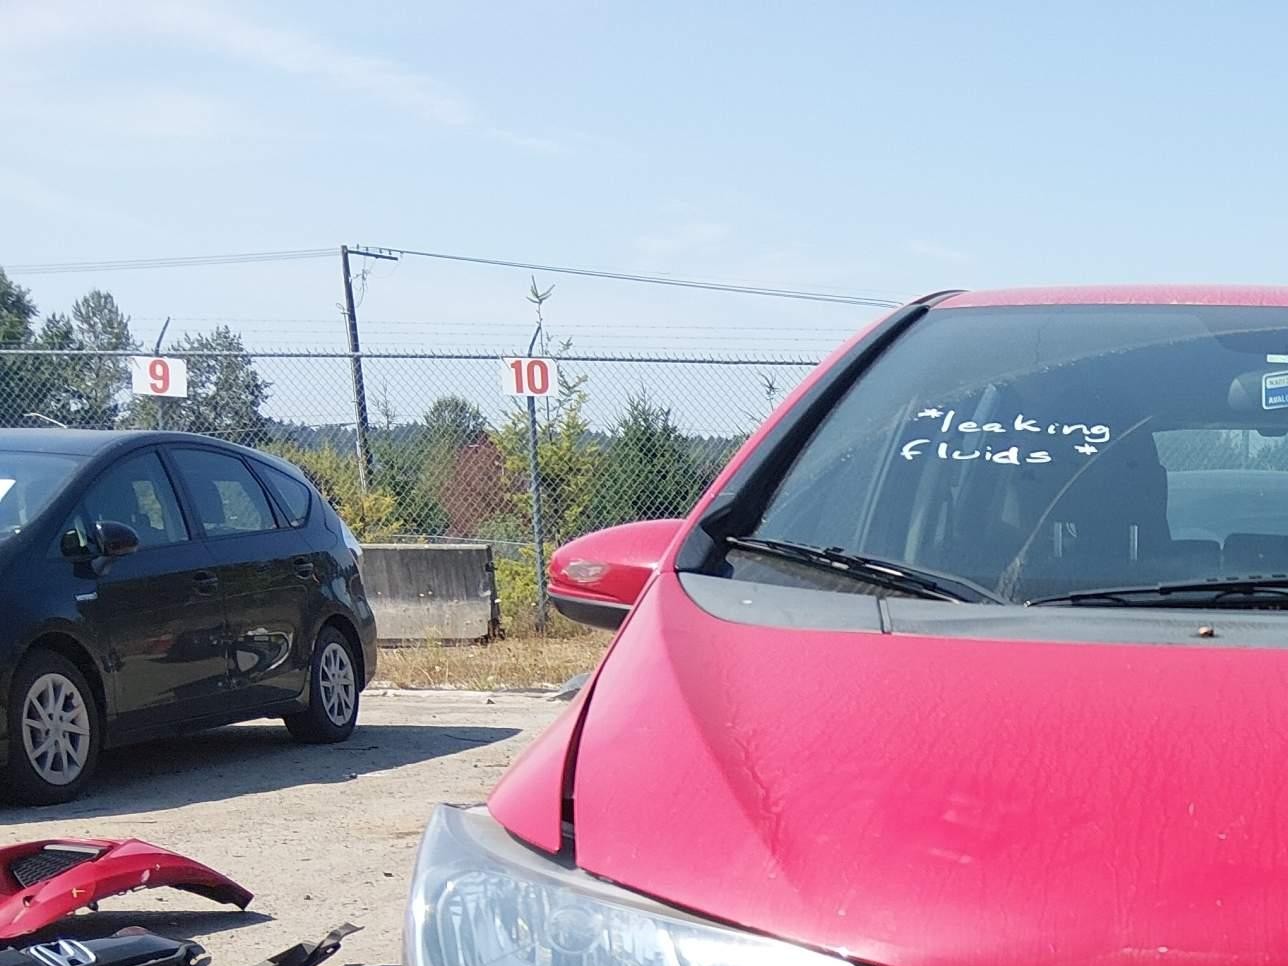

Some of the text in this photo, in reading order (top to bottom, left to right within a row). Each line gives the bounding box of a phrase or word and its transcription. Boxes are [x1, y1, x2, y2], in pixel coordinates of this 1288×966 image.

[149, 359, 170, 394] 9
[510, 359, 549, 395] 10
[900, 439, 1052, 465] fluids
